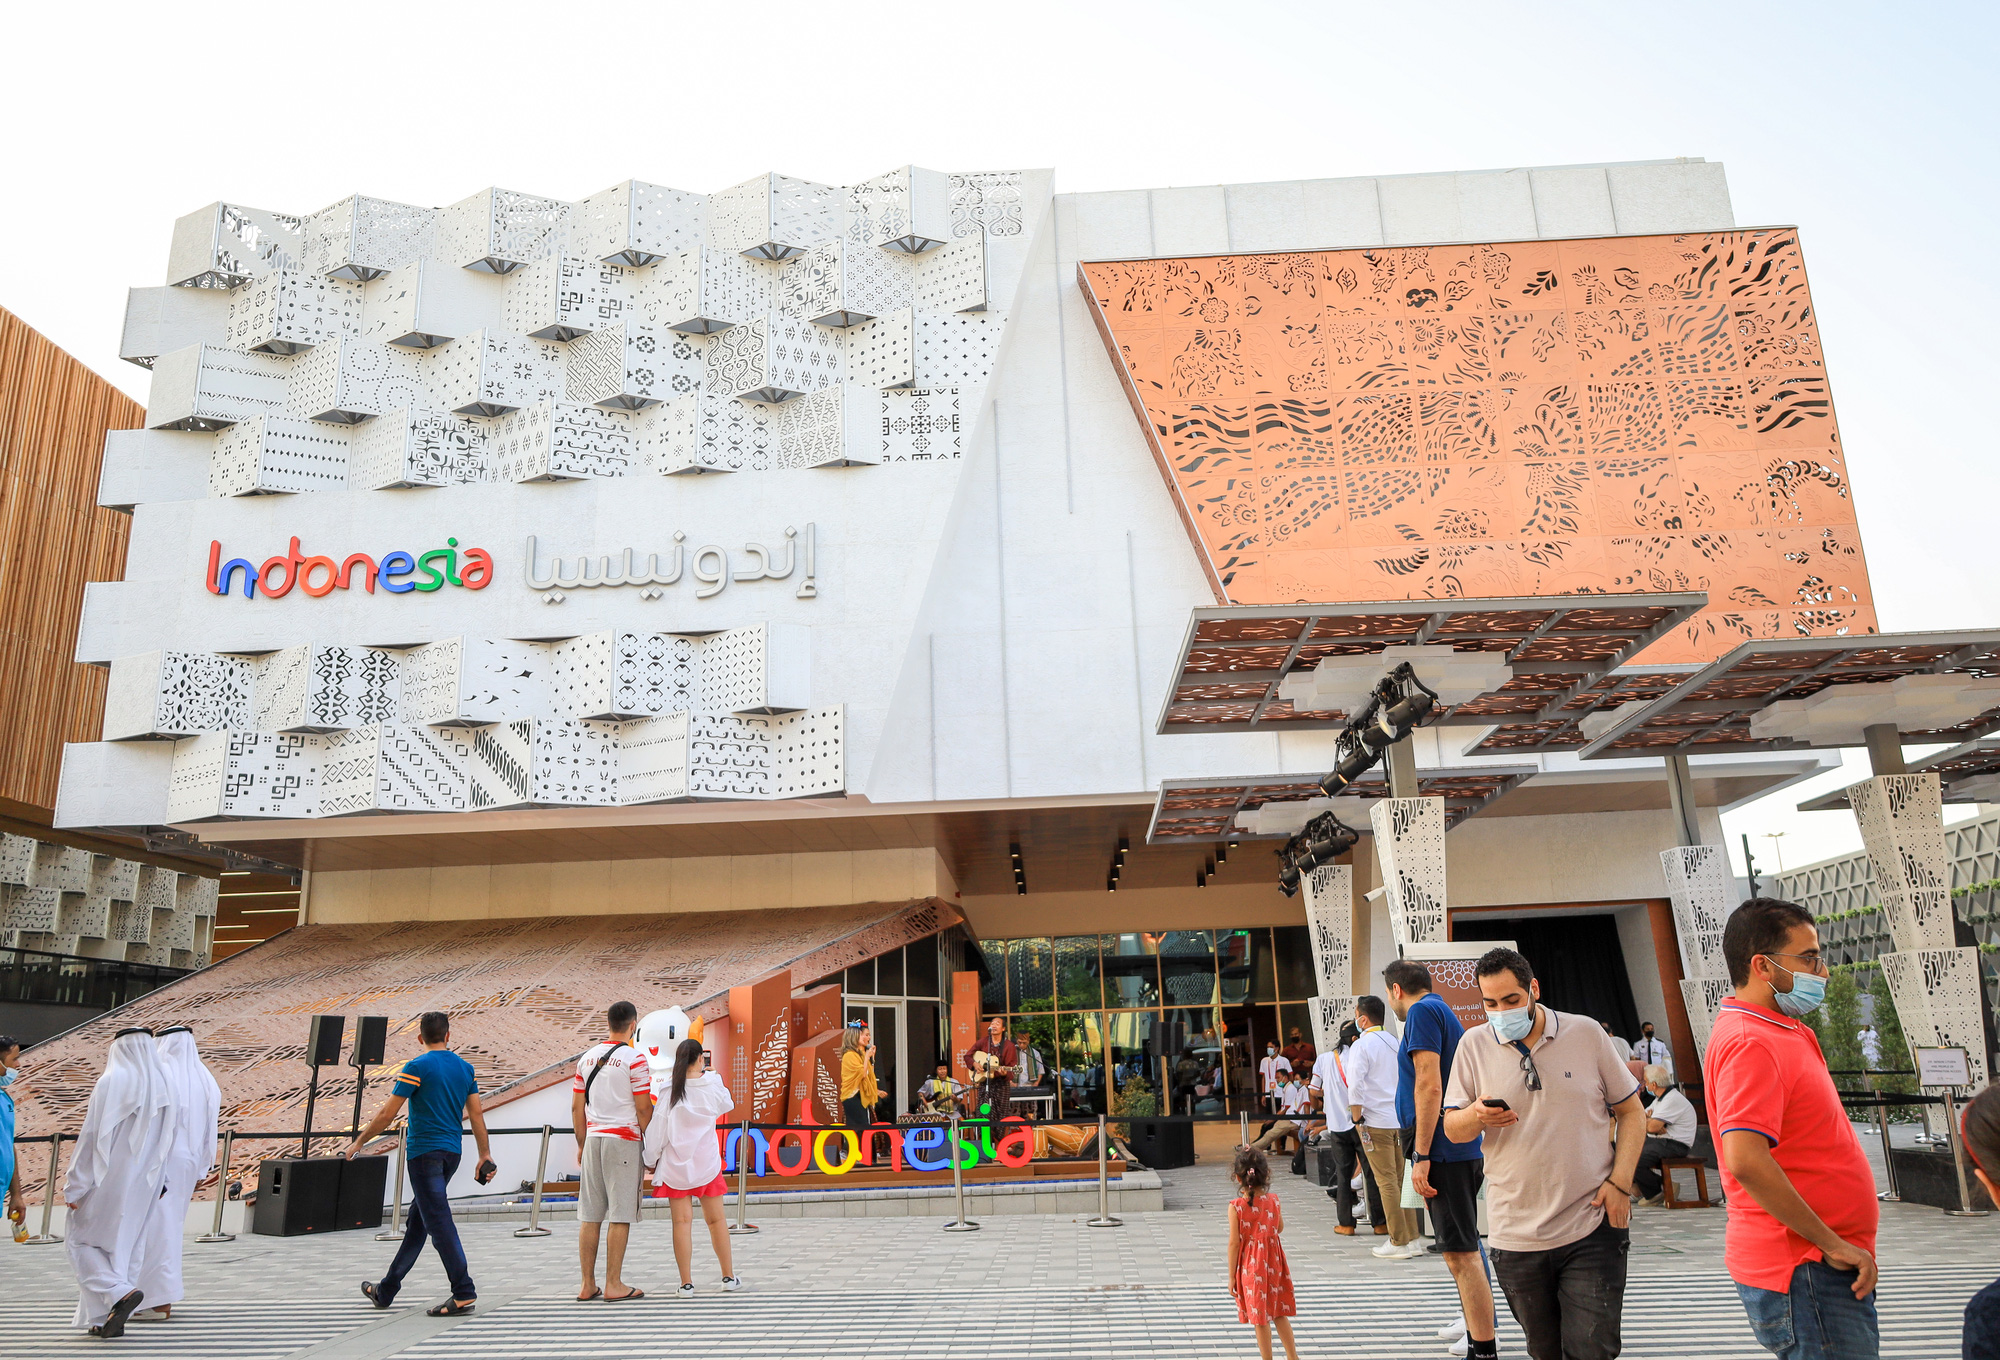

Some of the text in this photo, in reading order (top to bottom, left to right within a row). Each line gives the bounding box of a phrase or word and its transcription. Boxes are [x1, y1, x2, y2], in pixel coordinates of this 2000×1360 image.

[206, 536, 493, 600] Indonesia
[524, 522, 818, 604] إندونيسيا
[720, 1098, 1034, 1177] ndonesia
